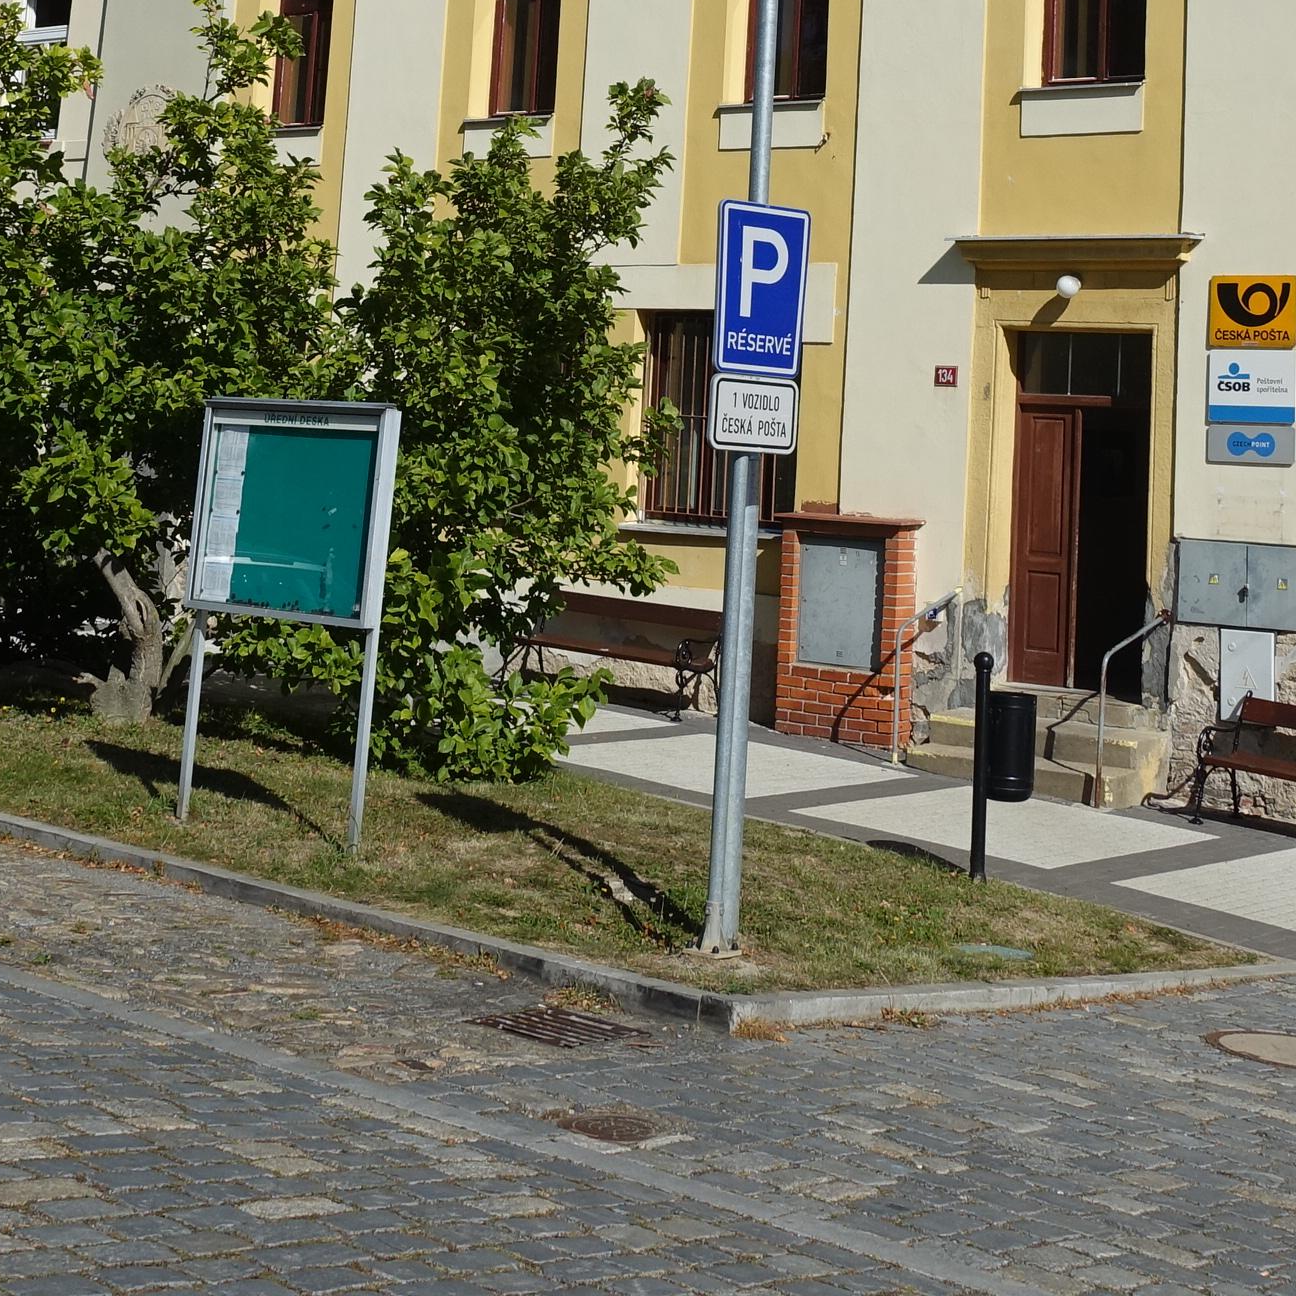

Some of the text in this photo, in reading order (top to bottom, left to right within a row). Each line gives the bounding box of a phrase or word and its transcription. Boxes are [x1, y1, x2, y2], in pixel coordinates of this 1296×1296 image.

[739, 225, 789, 318] P
[1215, 328, 1290, 341] ČESKÁ POŠTA
[727, 329, 792, 356] RÉSERVÉ
[937, 369, 953, 383] 134
[1256, 377, 1283, 385] Poštovní
[1217, 380, 1251, 392] ČSOB
[1256, 385, 1288, 394] spořitelna
[733, 392, 780, 412] 1 VOZIDLO
[299, 415, 330, 426] DESKA
[721, 412, 786, 438] ČESKÁ POŠTA
